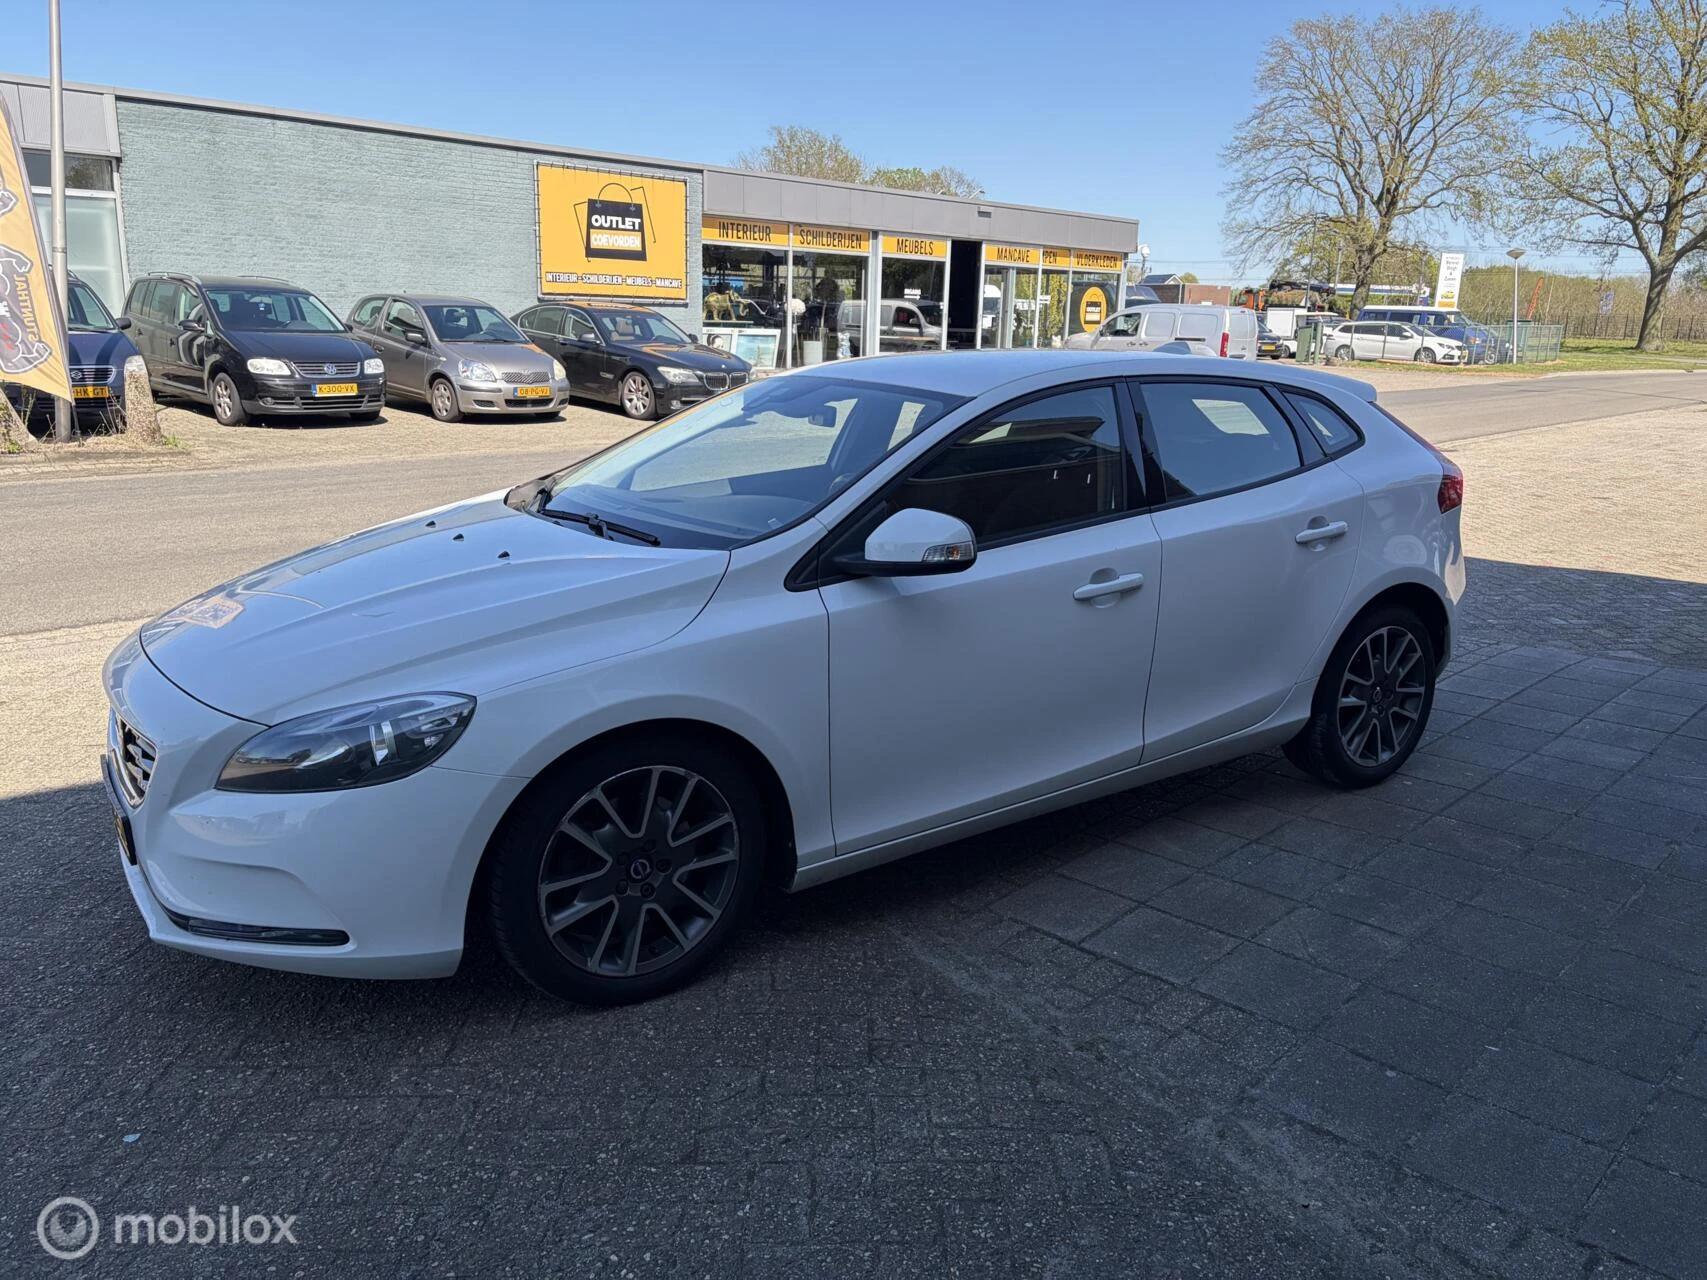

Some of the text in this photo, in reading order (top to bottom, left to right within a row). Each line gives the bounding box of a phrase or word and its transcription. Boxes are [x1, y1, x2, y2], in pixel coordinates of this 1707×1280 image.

[591, 214, 641, 230] OUTLET
[718, 221, 771, 242] INTERIEUR
[799, 229, 862, 250] SCHILDERIJEN
[591, 234, 640, 248] COEVORDEN
[896, 238, 934, 256] MEUBELS
[997, 247, 1030, 263] MANCAVE
[1076, 252, 1118, 269] VLOERKLEDEN
[545, 272, 578, 283] INTERIEUR
[626, 275, 652, 287] MEUBELS
[655, 277, 682, 289] MANCAVE
